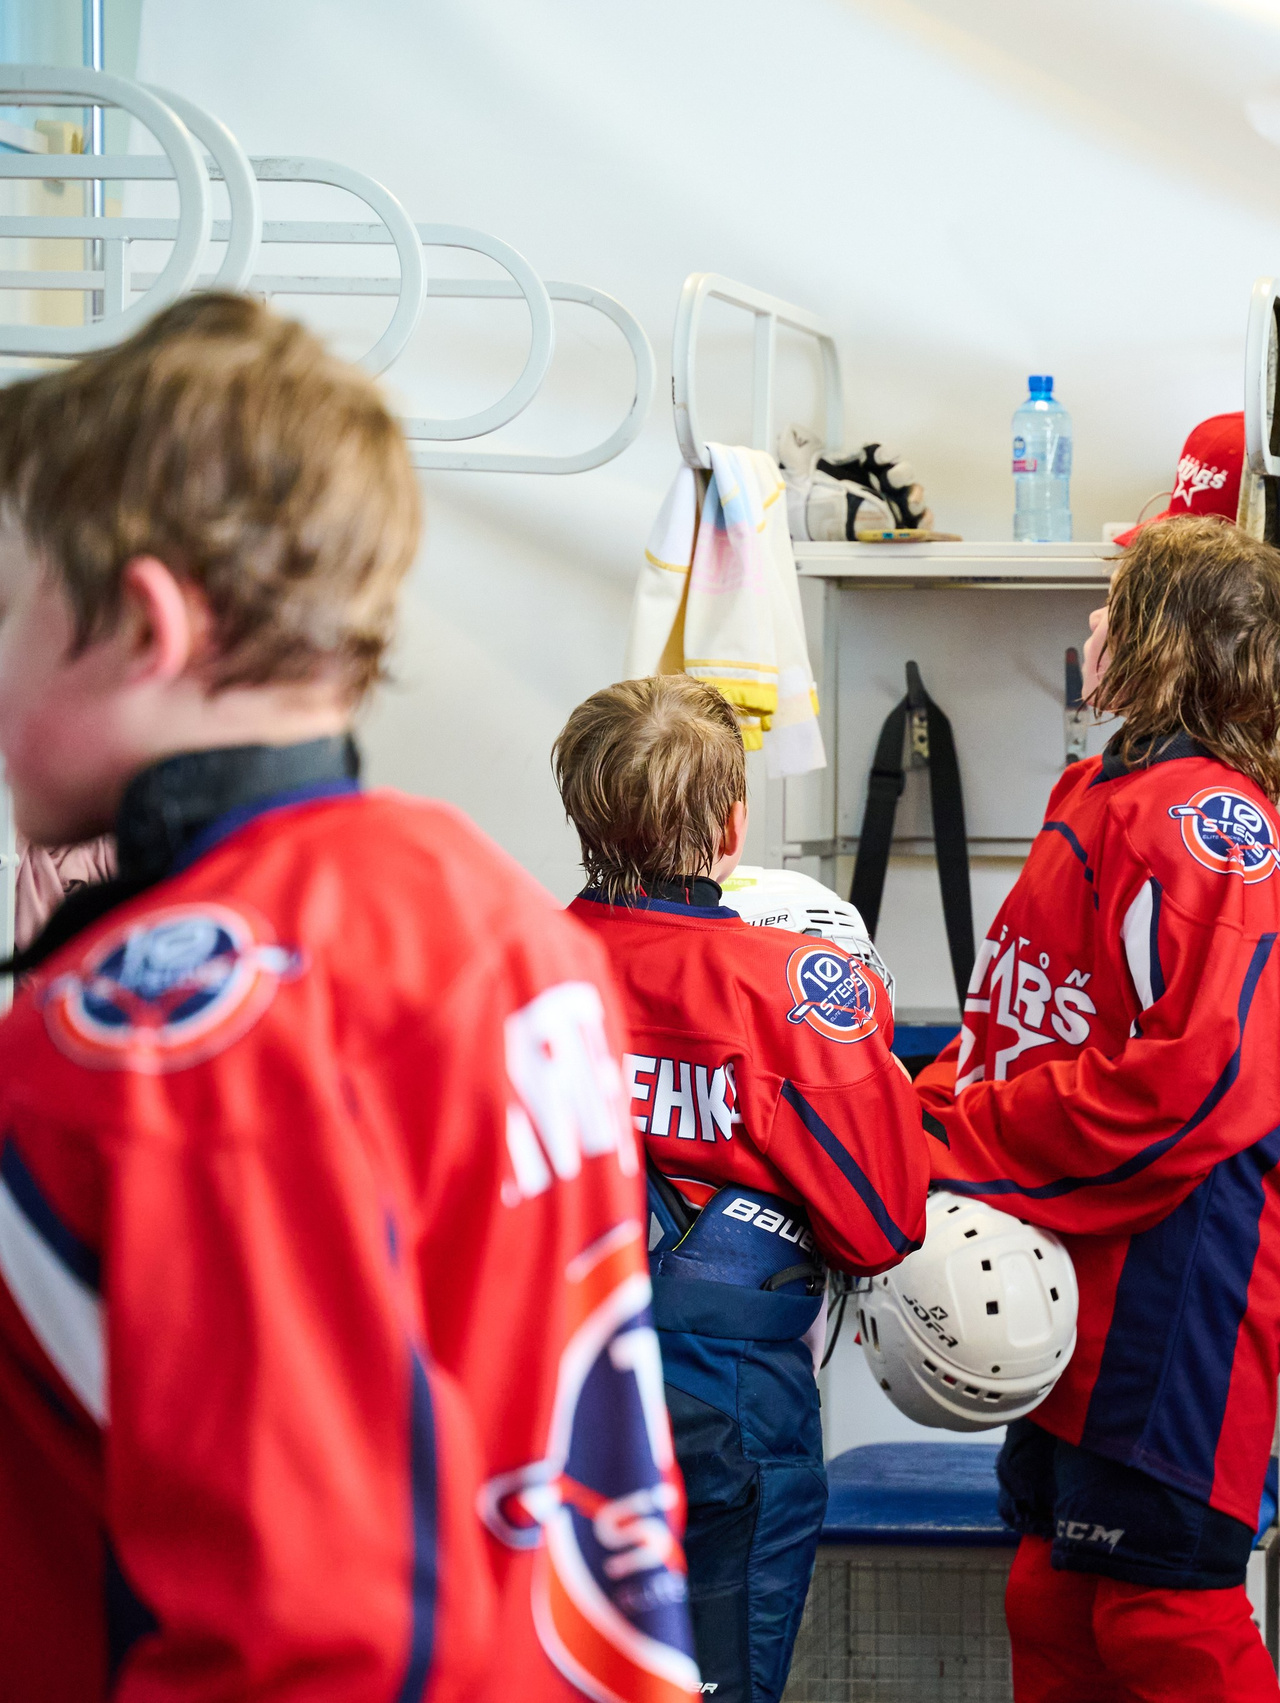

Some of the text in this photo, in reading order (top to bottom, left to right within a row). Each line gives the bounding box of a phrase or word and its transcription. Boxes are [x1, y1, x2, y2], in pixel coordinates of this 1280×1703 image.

[1220, 796, 1263, 833] 10
[746, 914, 789, 927] UER
[803, 957, 843, 991] 10
[820, 972, 863, 1016] STEPS
